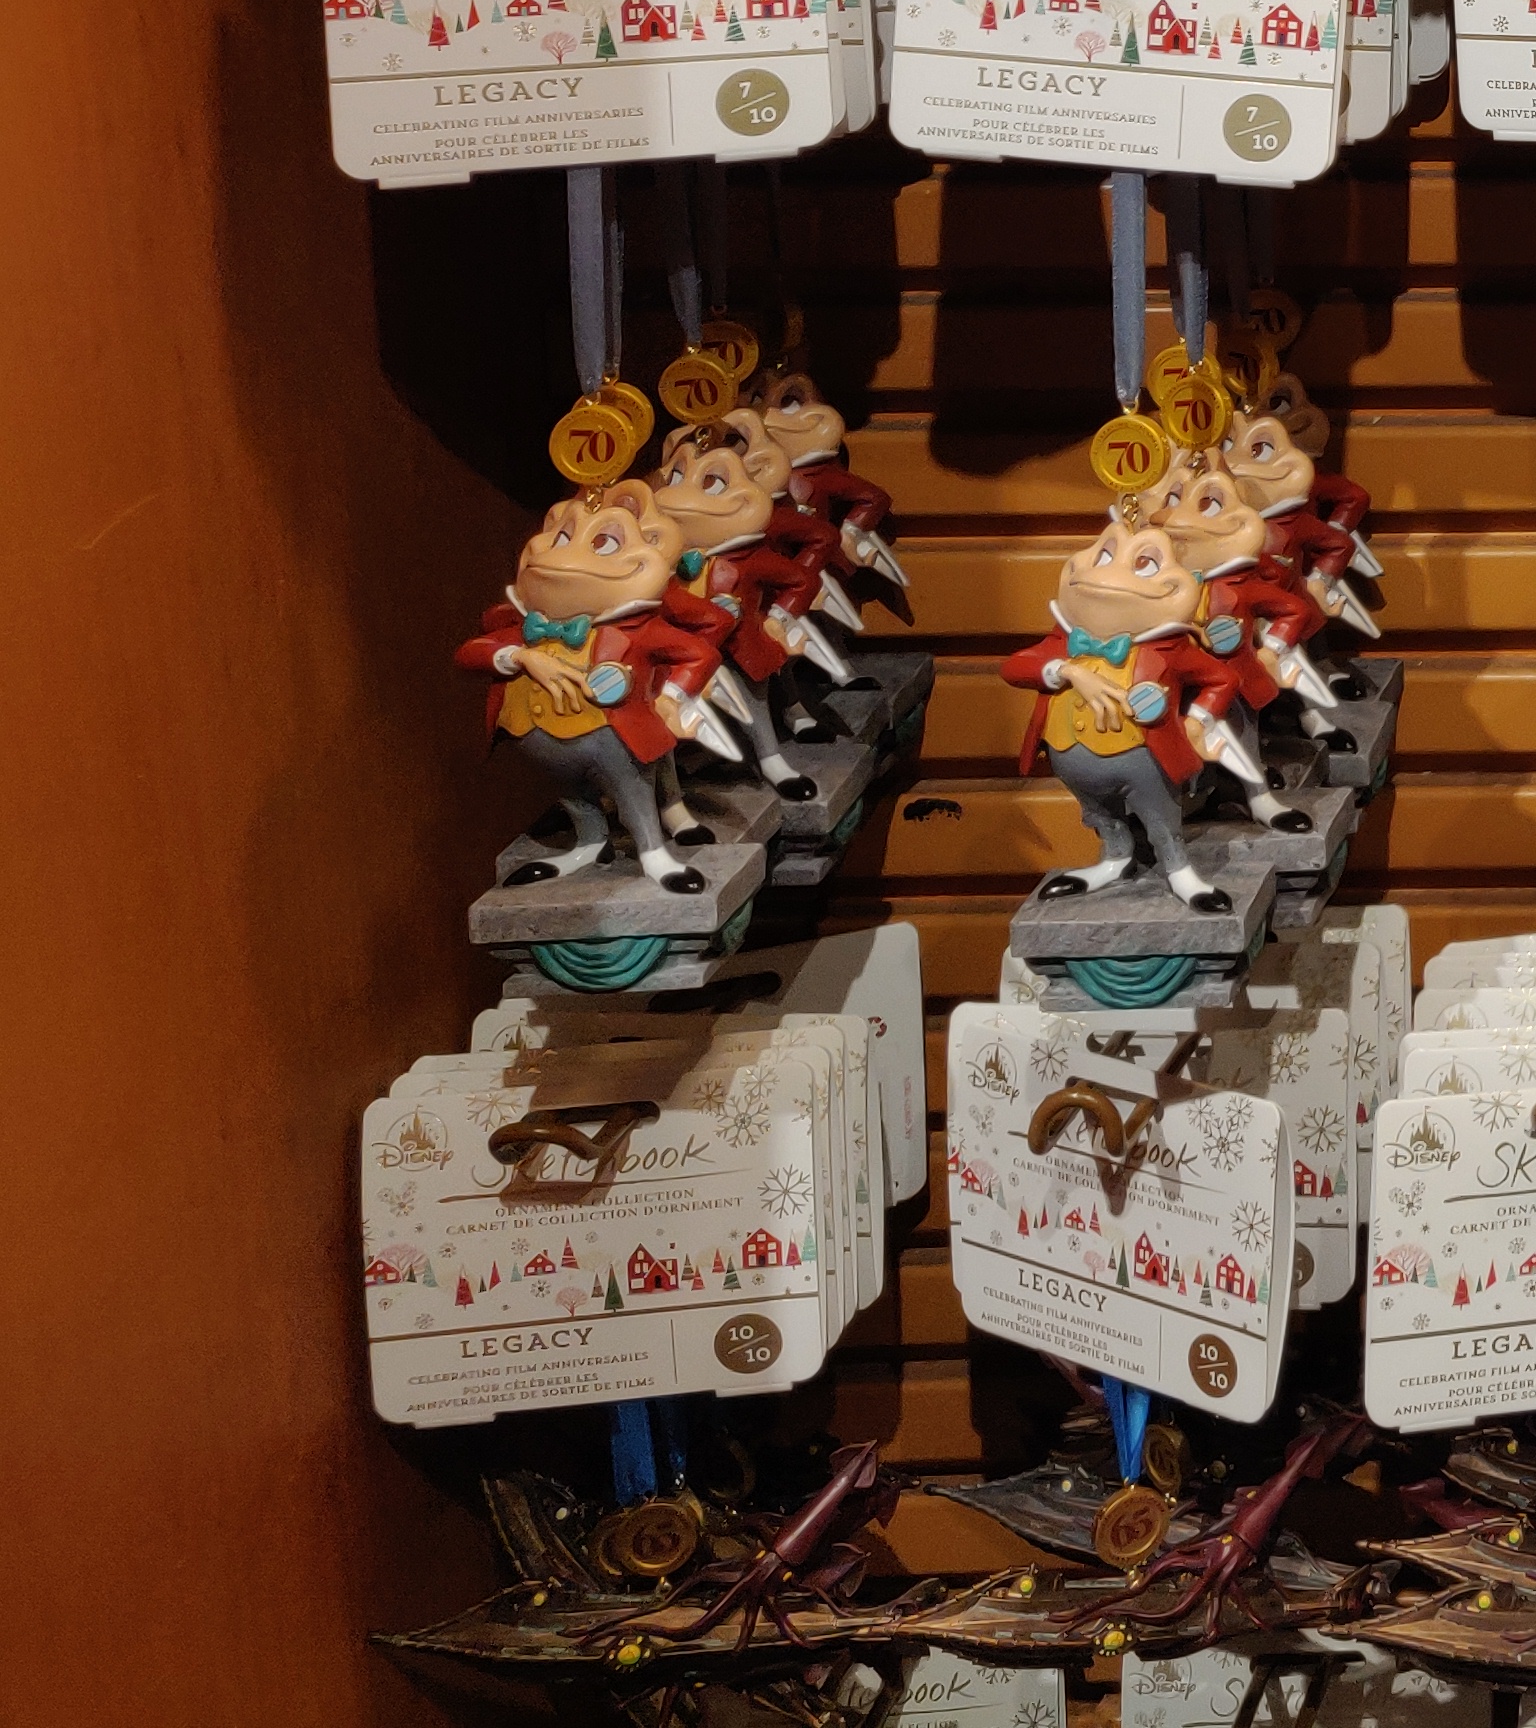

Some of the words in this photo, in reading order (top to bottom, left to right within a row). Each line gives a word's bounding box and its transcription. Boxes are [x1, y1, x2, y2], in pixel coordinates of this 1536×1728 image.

[433, 77, 584, 107] LEGACY
[976, 67, 1108, 97] LEGACY
[569, 428, 615, 463] 70
[1109, 441, 1148, 475] 70
[1018, 1268, 1108, 1313] LEGACY
[459, 1327, 594, 1358] LEGACY
